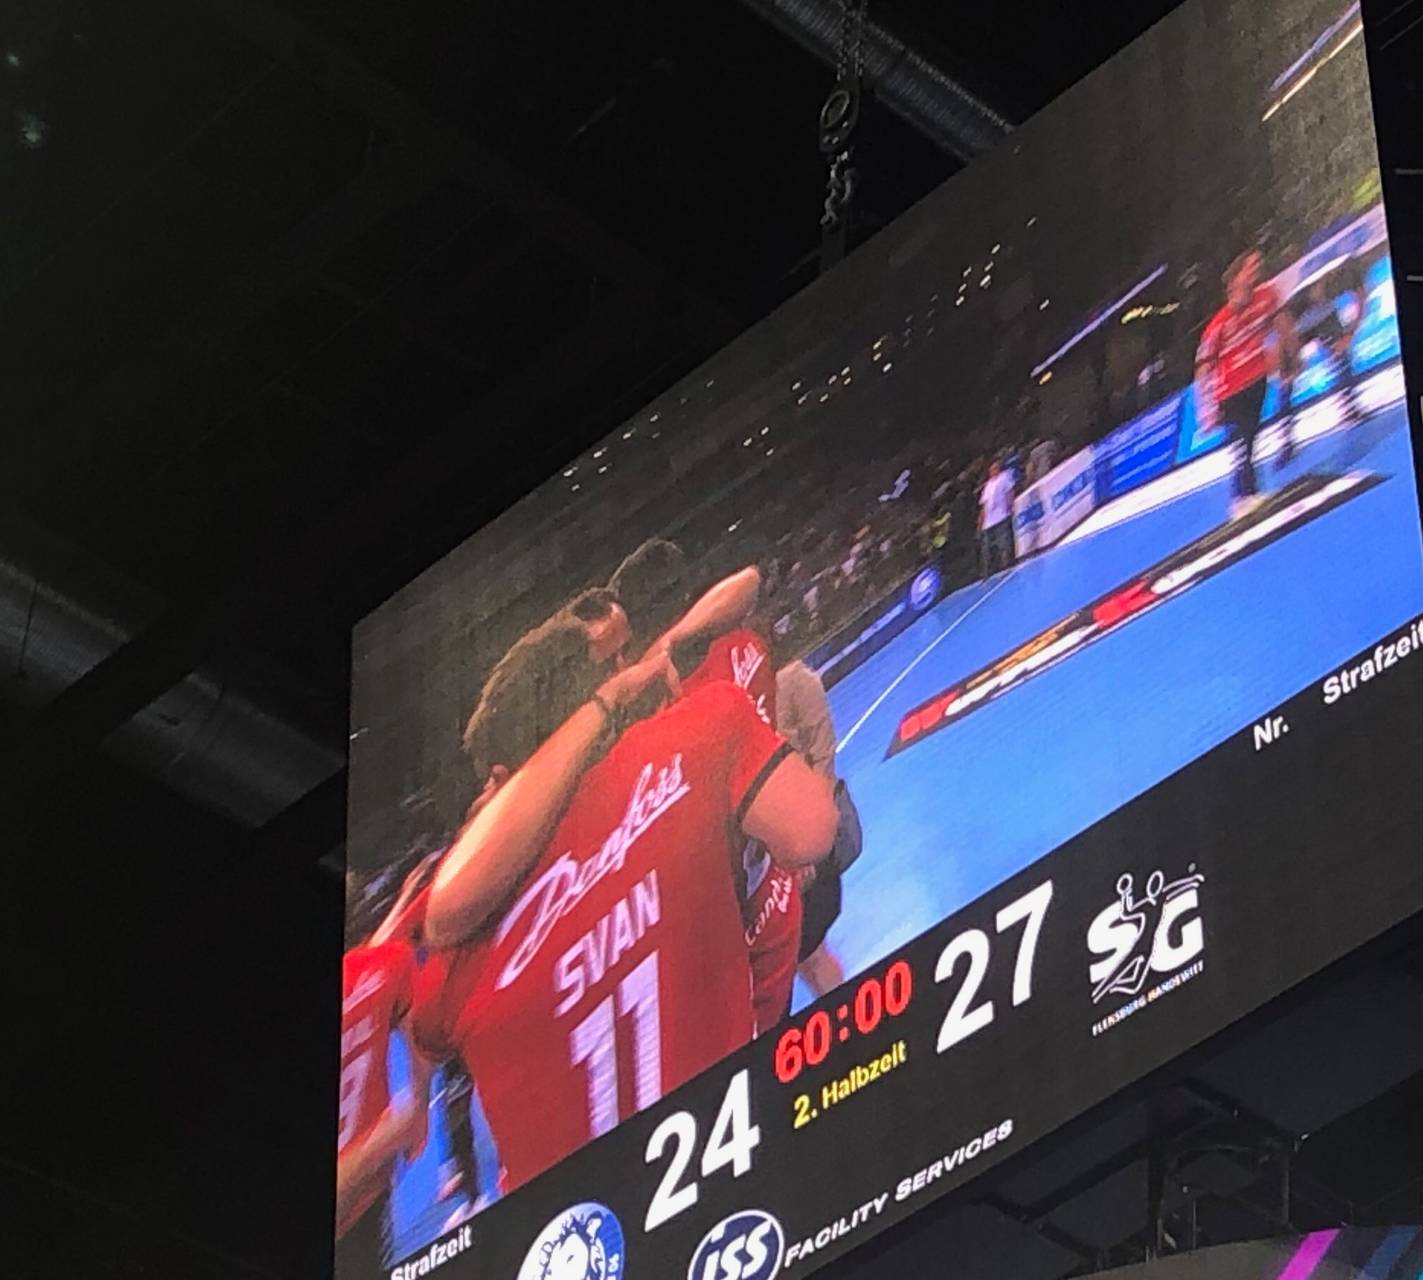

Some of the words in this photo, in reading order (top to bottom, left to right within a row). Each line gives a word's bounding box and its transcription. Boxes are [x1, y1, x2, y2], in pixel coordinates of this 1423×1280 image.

[1253, 714, 1290, 752] Nr.
[493, 752, 691, 992] Danfoss
[553, 868, 661, 1018] SVAN
[774, 960, 913, 1084] 60:00
[934, 879, 1054, 1054] 27
[569, 949, 662, 1138] 11
[793, 1095, 819, 1129] 2.
[821, 1040, 907, 1104] Halbzeit
[643, 1067, 761, 1233] 24
[784, 1192, 889, 1268] FACILITY
[895, 1119, 1014, 1201] SERVICES
[390, 1225, 472, 1280] Strafzeit
